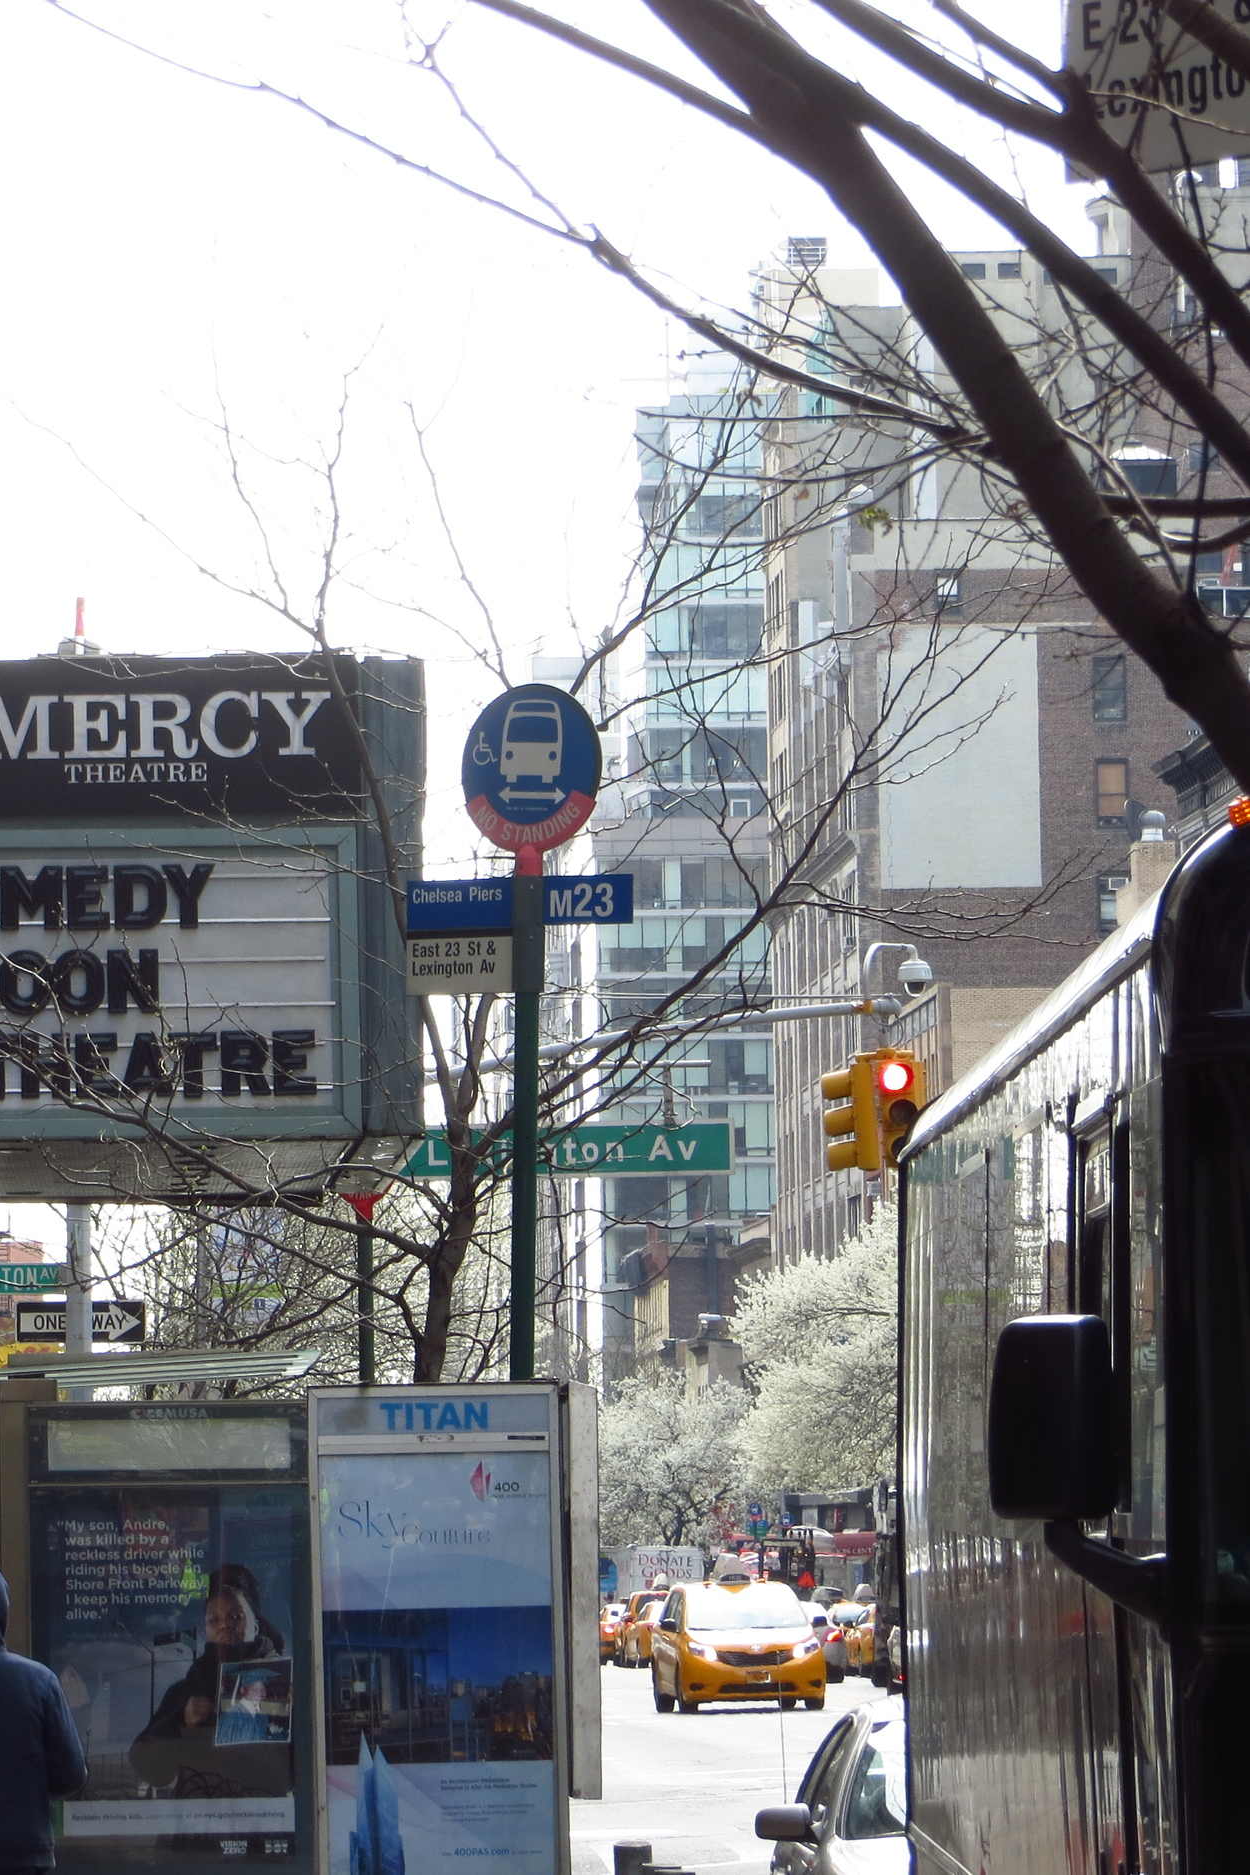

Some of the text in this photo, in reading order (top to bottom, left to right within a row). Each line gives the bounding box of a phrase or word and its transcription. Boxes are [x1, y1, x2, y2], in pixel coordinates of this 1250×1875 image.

[64, 762, 209, 785] THEATRE
[475, 802, 581, 844] NO STANDING
[412, 885, 503, 905] Chelsea Piers
[549, 882, 615, 919] M23
[412, 940, 497, 959] East 23 St &
[412, 959, 496, 979] Lexington Av
[649, 1134, 698, 1164] Av
[39, 1266, 59, 1280] AV
[33, 1313, 127, 1331] ONE WAY
[145, 1407, 209, 1420] CEMUSA
[379, 1402, 489, 1431] TITAN
[494, 1482, 520, 1493] 400
[89, 1520, 118, 1532] son,
[122, 1518, 170, 1531] Andre,
[338, 1500, 406, 1549] Sky
[65, 1533, 170, 1547] was killed by a
[65, 1547, 205, 1561] reckless driver while
[637, 1554, 694, 1568] DONATE
[65, 1563, 201, 1577] riding his bicycle on
[641, 1565, 693, 1579] GOODS
[65, 1578, 207, 1591] Shore Front Parkway.
[74, 1593, 108, 1607] keep
[111, 1593, 131, 1605] his
[134, 1595, 192, 1607] memory
[219, 1840, 248, 1848] VISION
[222, 1847, 247, 1855] ZERO
[264, 1843, 289, 1854] DOT
[453, 1847, 510, 1857] 400PAS.com
